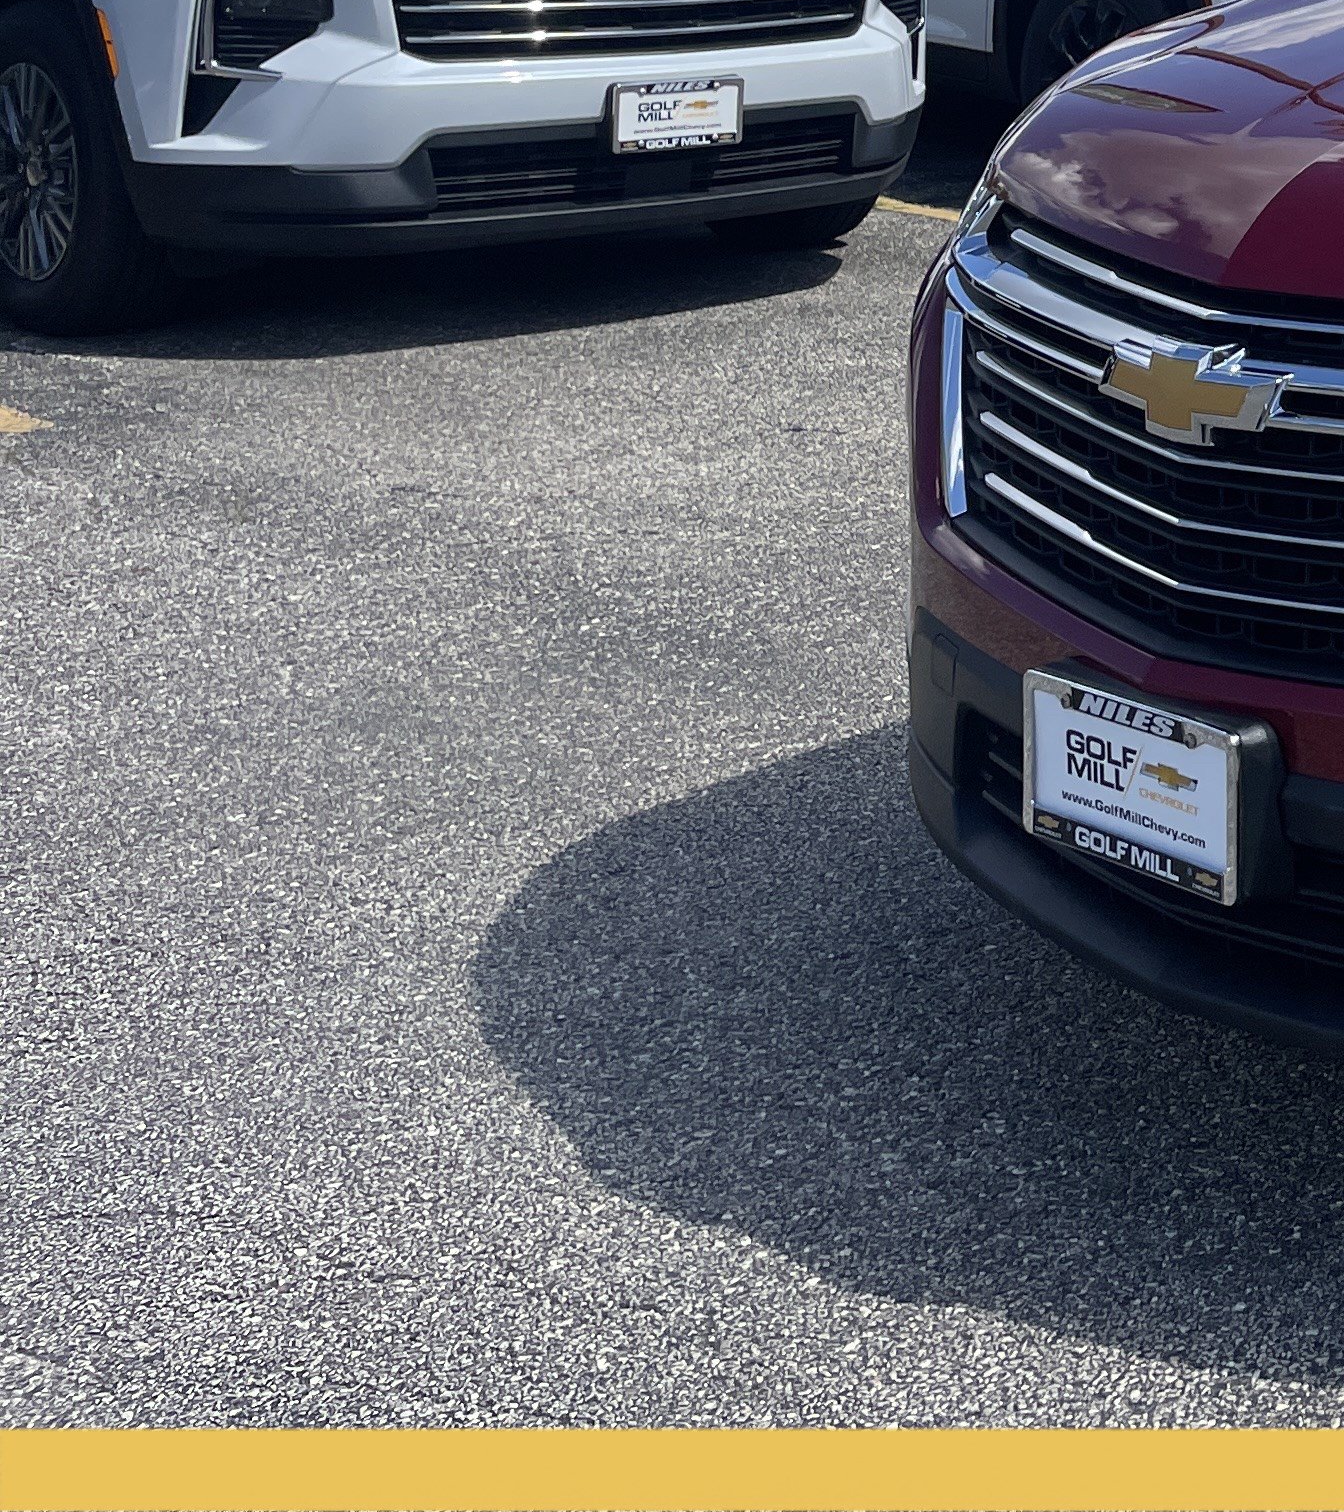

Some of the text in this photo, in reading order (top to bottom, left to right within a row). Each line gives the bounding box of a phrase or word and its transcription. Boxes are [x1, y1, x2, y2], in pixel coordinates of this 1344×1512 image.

[638, 99, 682, 112] GOLF
[651, 80, 711, 94] NILES
[637, 110, 673, 123] MILL
[645, 135, 711, 150] GOLF MILL
[1078, 692, 1176, 738] NILES
[1066, 729, 1137, 769] GOLF
[1066, 752, 1126, 792] MILL
[1061, 790, 1207, 849] www.GolfMillChevy.com
[1074, 825, 1180, 883] GOLF MILL
